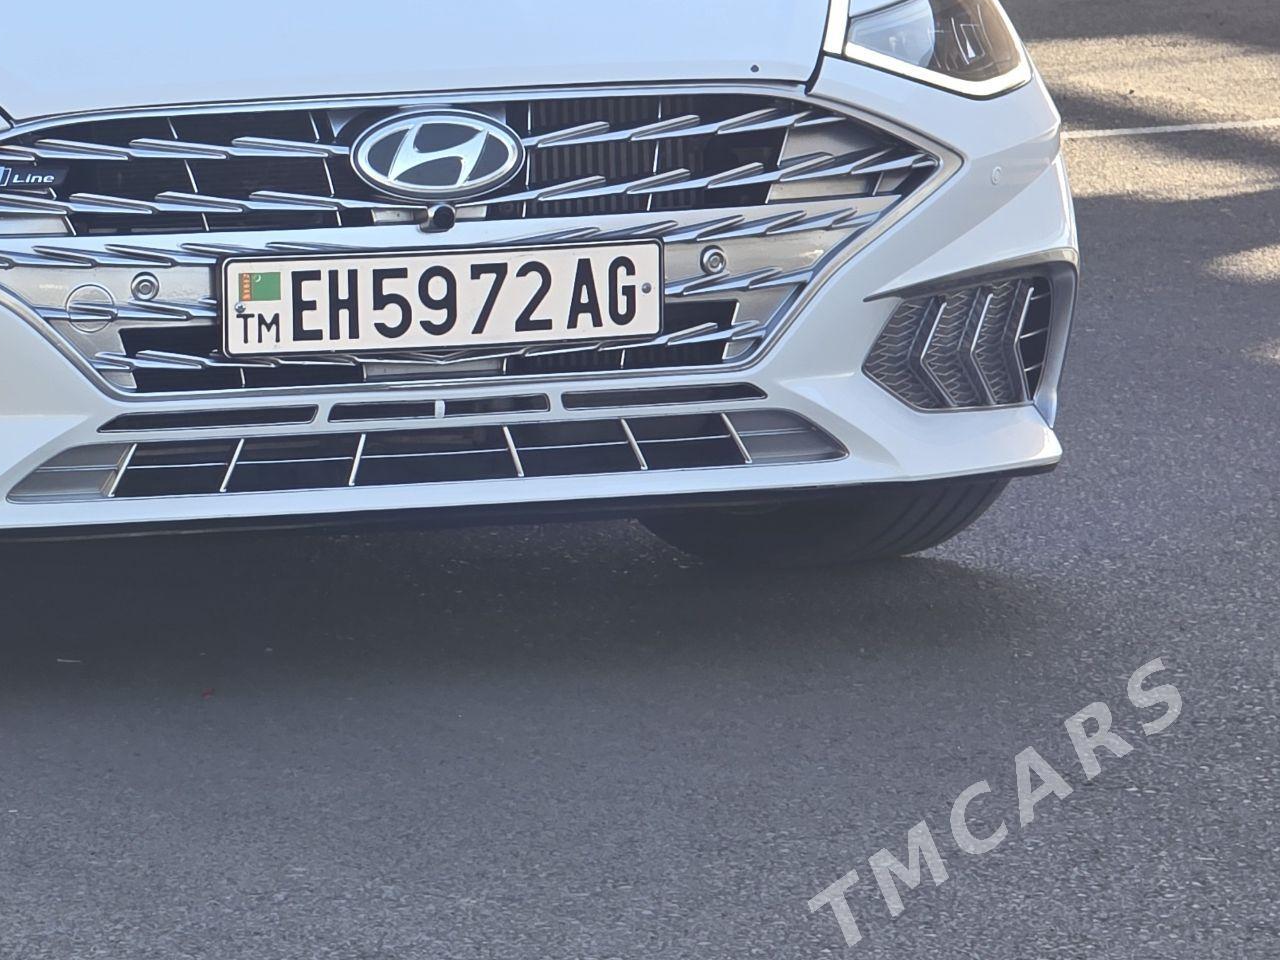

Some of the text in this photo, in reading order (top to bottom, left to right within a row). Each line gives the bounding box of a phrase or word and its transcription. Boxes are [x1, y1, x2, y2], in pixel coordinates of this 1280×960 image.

[13, 173, 55, 183] Line
[236, 255, 637, 344] TM EH5972AG
